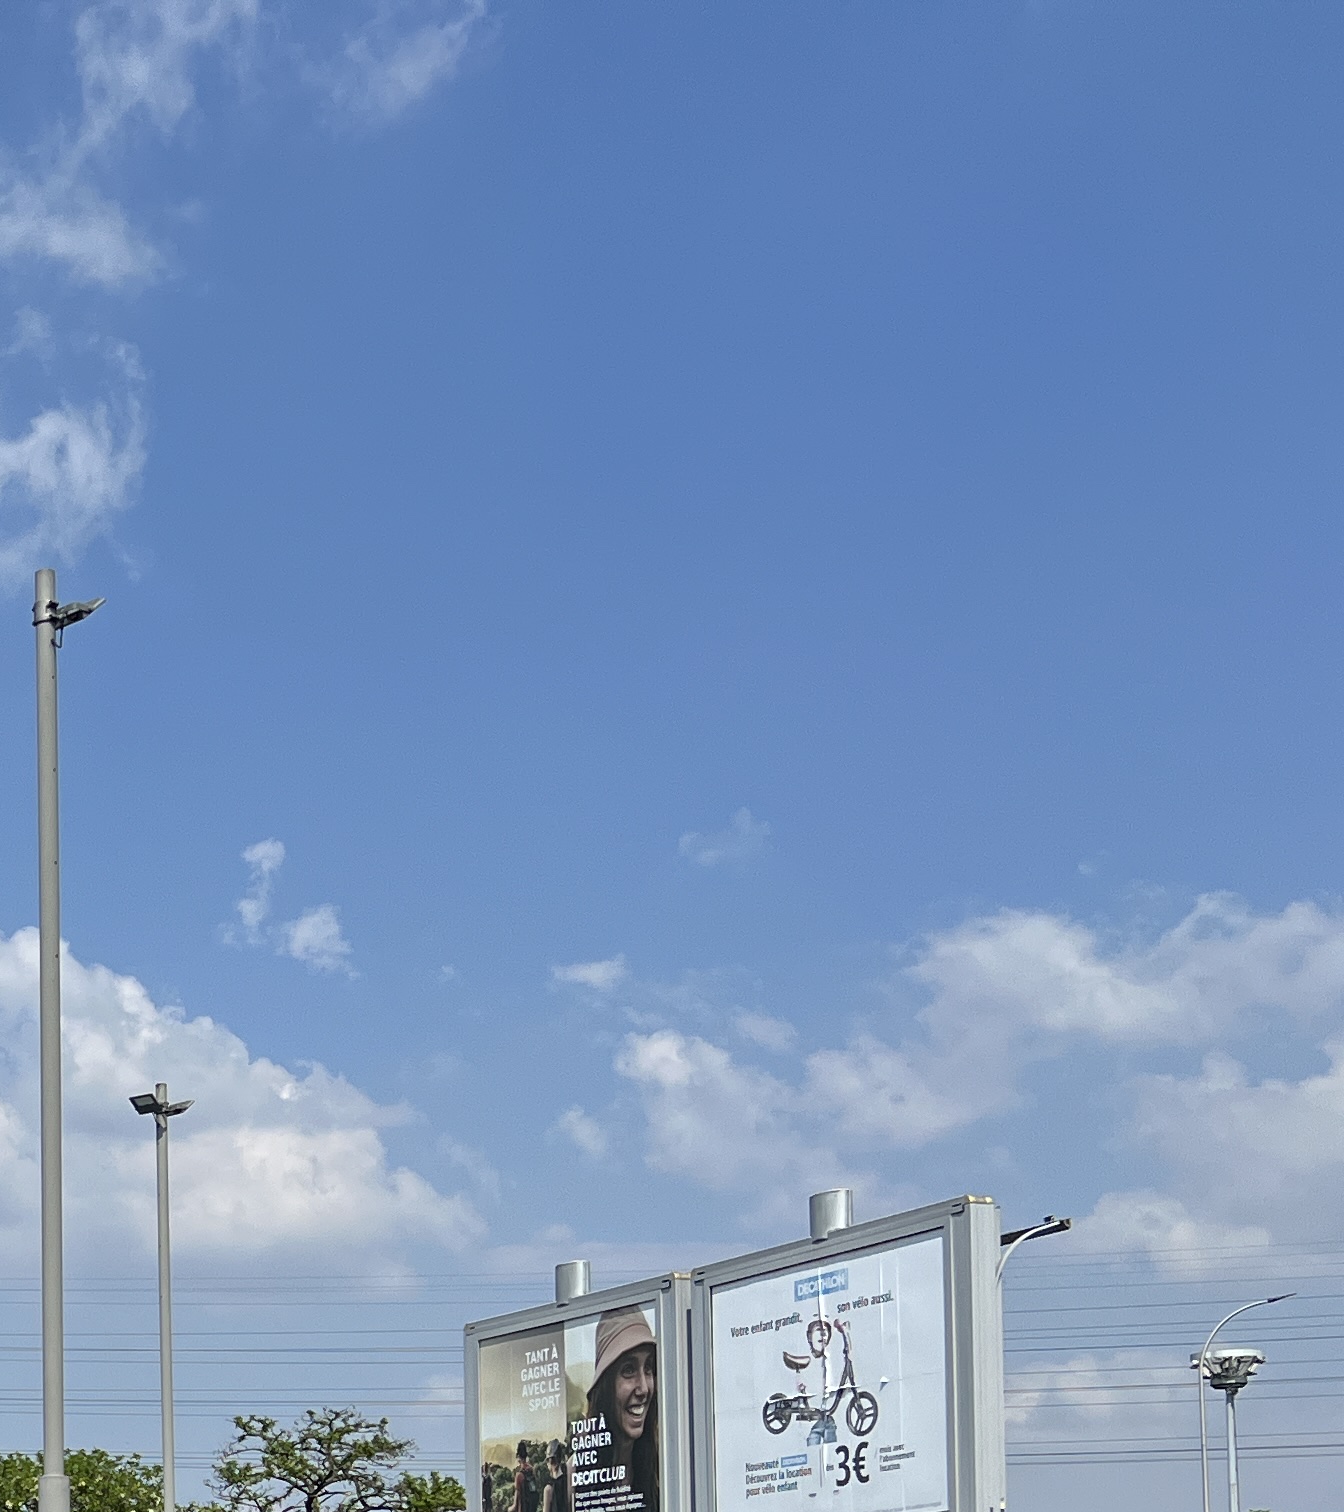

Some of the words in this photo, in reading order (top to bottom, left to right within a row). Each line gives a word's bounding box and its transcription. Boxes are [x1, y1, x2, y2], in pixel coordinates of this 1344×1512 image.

[525, 1348, 549, 1365] TANT
[551, 1343, 558, 1360] À
[520, 1362, 560, 1381] GAGNER
[522, 1381, 546, 1397] AVEC
[548, 1378, 560, 1392] LE
[529, 1394, 561, 1412] SPORT
[571, 1417, 597, 1434] TOUT
[598, 1412, 606, 1430] À
[571, 1432, 612, 1451] GAGNER
[572, 1450, 598, 1467] AVEC
